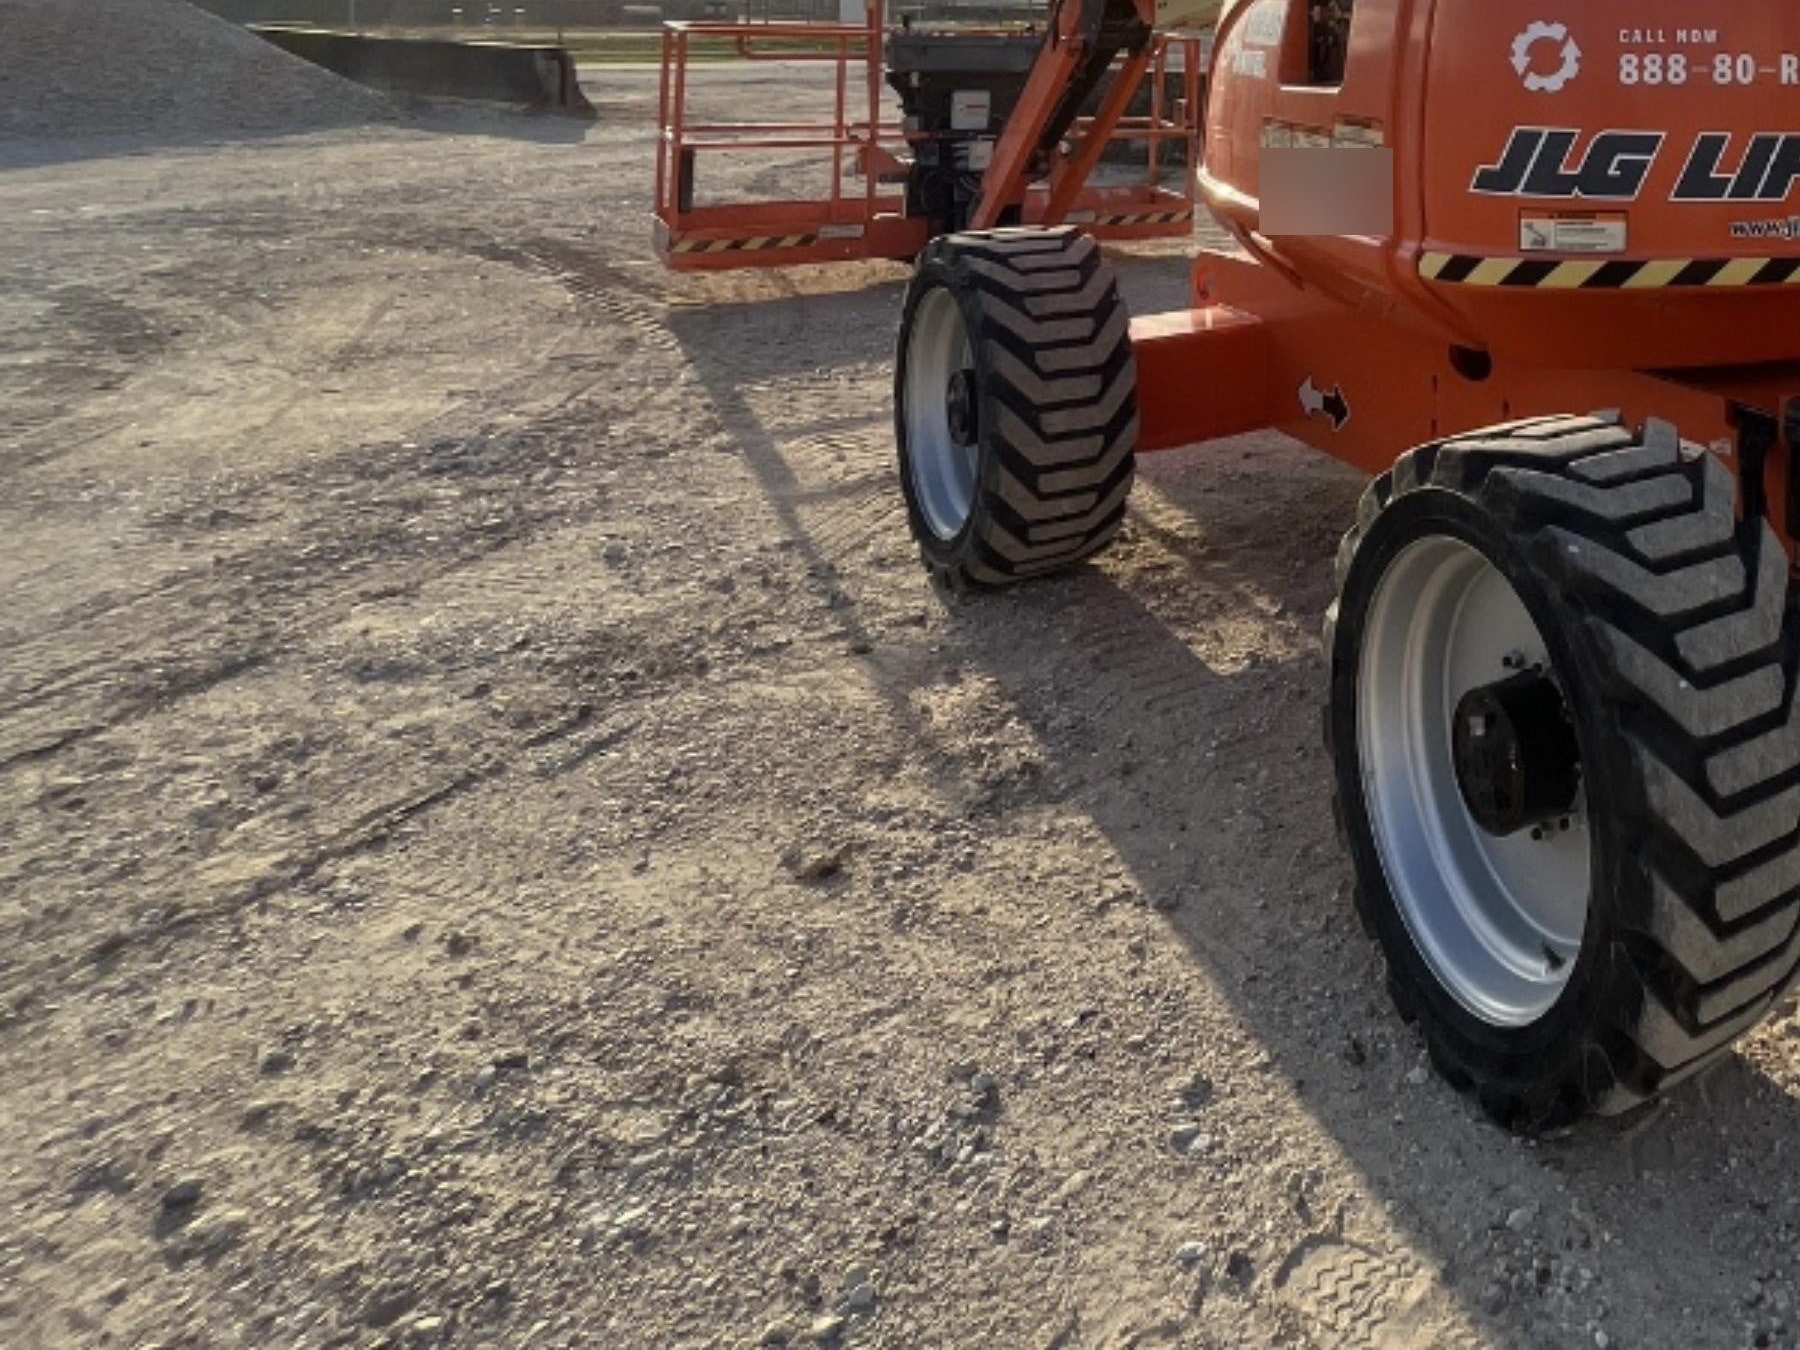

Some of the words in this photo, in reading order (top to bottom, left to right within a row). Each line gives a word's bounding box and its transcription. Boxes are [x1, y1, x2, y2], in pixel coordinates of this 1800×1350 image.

[1619, 29, 1666, 43] CALL
[1677, 29, 1718, 43] NOW
[1467, 125, 1667, 201] JLG
